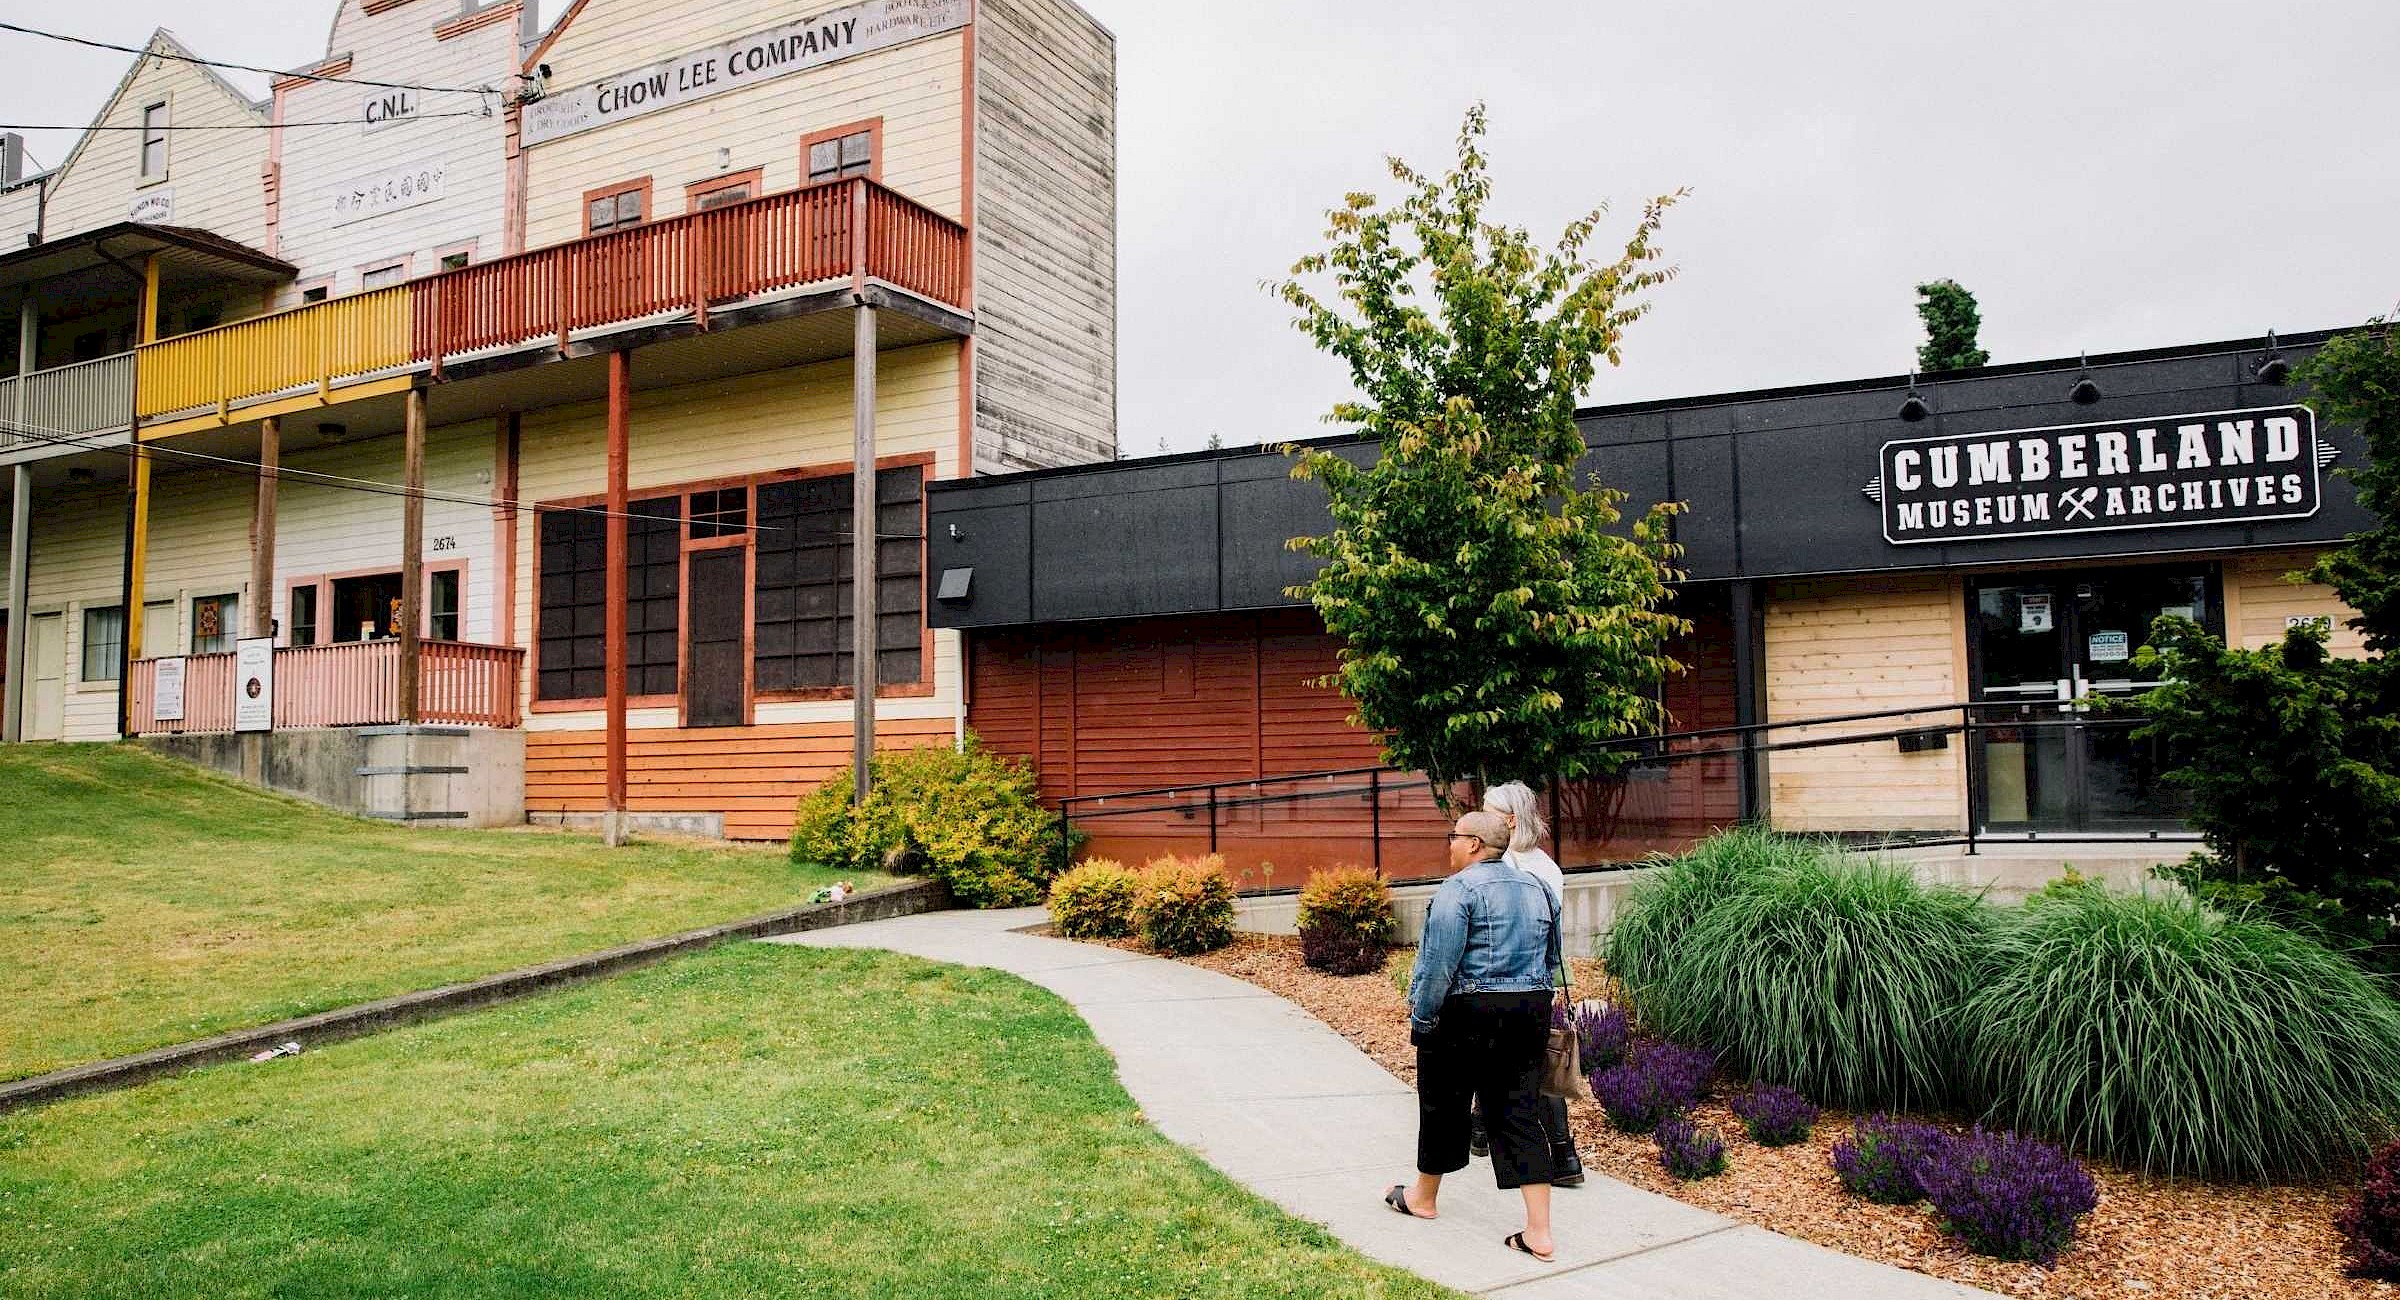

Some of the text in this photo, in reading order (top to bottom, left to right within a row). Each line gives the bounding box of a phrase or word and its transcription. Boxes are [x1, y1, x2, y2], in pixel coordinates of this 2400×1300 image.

[597, 18, 857, 114] CHOW LEE COMPANY
[1894, 416, 2300, 492] CUMBERLAND
[1898, 473, 2302, 531] MUSEUM ARCHIVES
[433, 535, 456, 551] 2674
[2091, 634, 2125, 645] NOTICE
